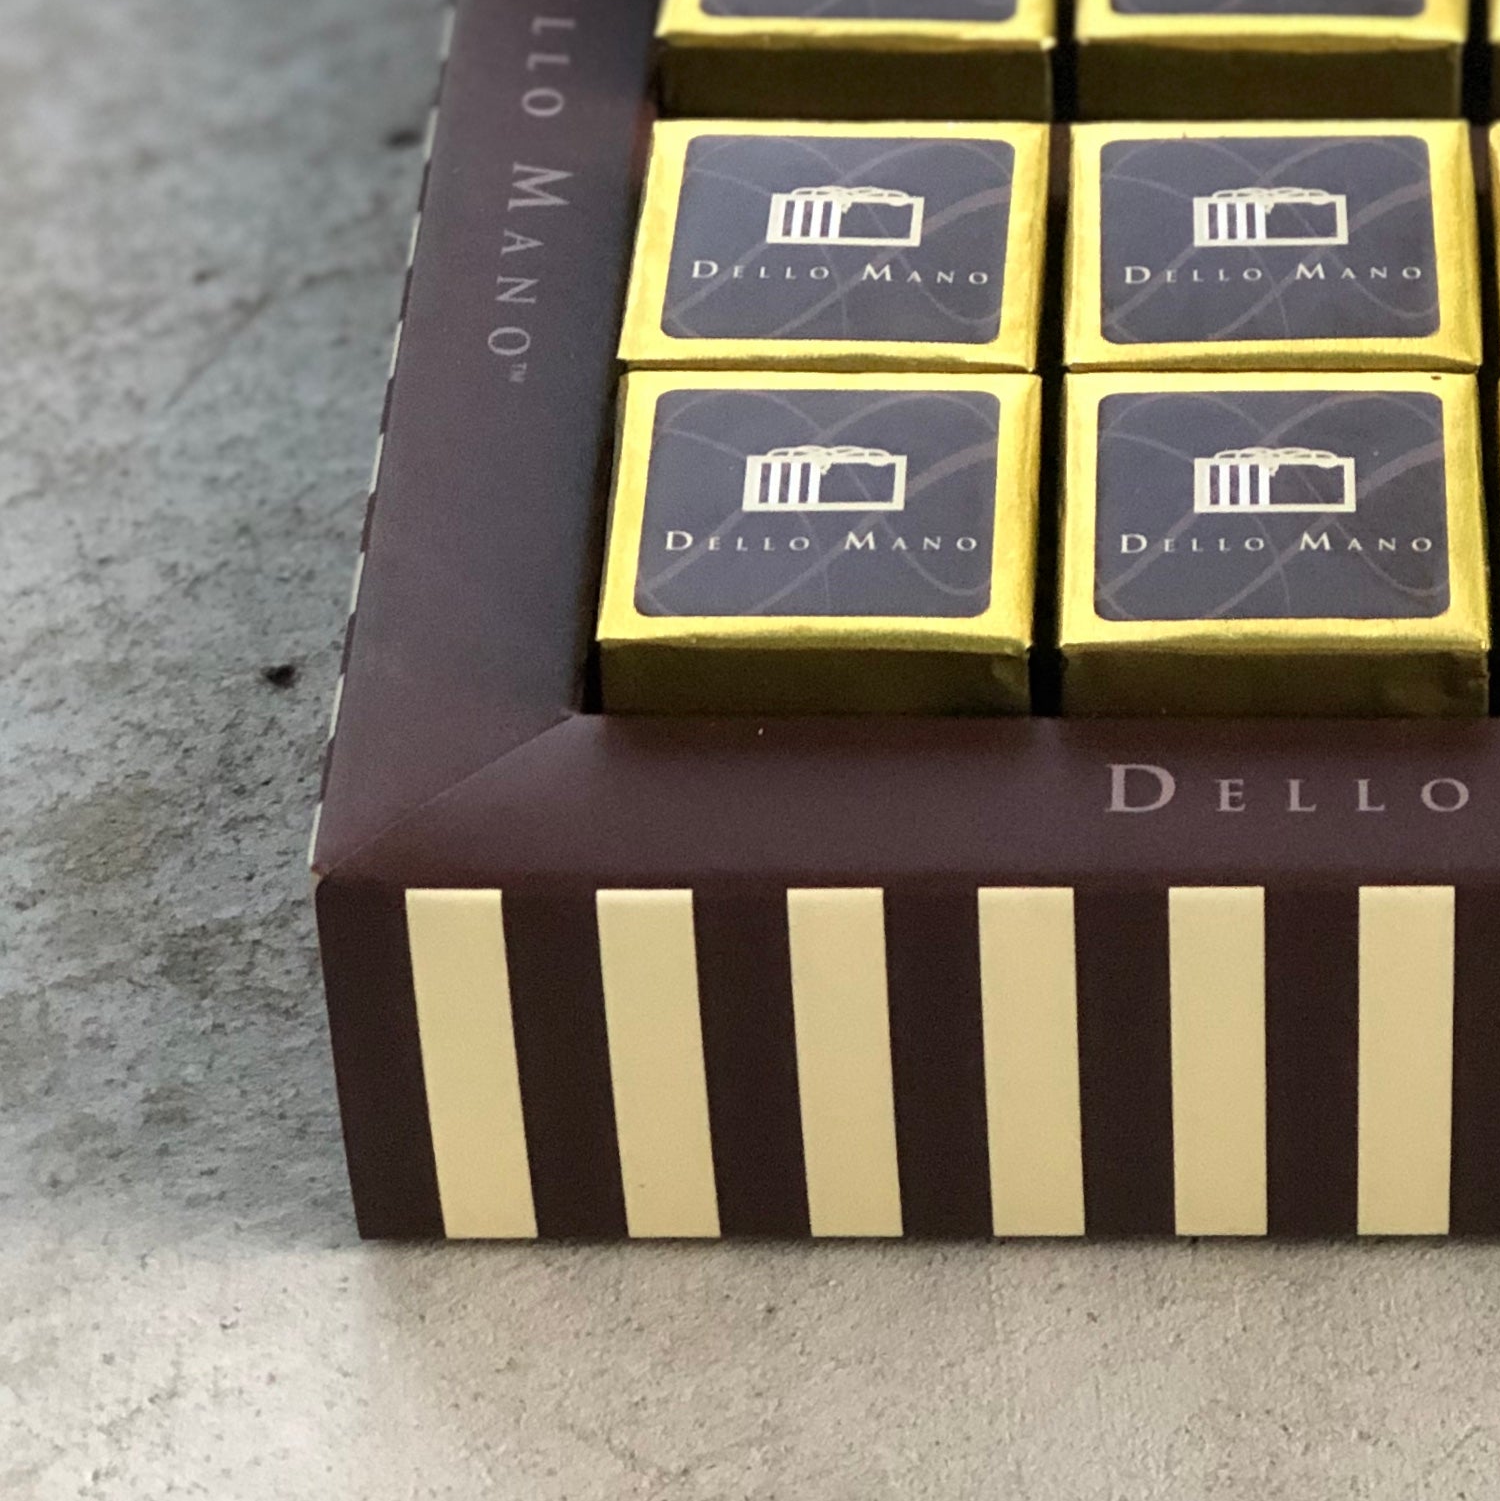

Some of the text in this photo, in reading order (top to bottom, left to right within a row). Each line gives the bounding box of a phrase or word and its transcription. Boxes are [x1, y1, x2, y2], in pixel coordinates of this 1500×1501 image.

[691, 259, 989, 286] DELLO MANO
[1124, 261, 1423, 286] DELLO MANO
[665, 529, 978, 552] DELLO MANO
[1120, 530, 1434, 555] DELLO MANO
[1106, 762, 1471, 814] DELLO
